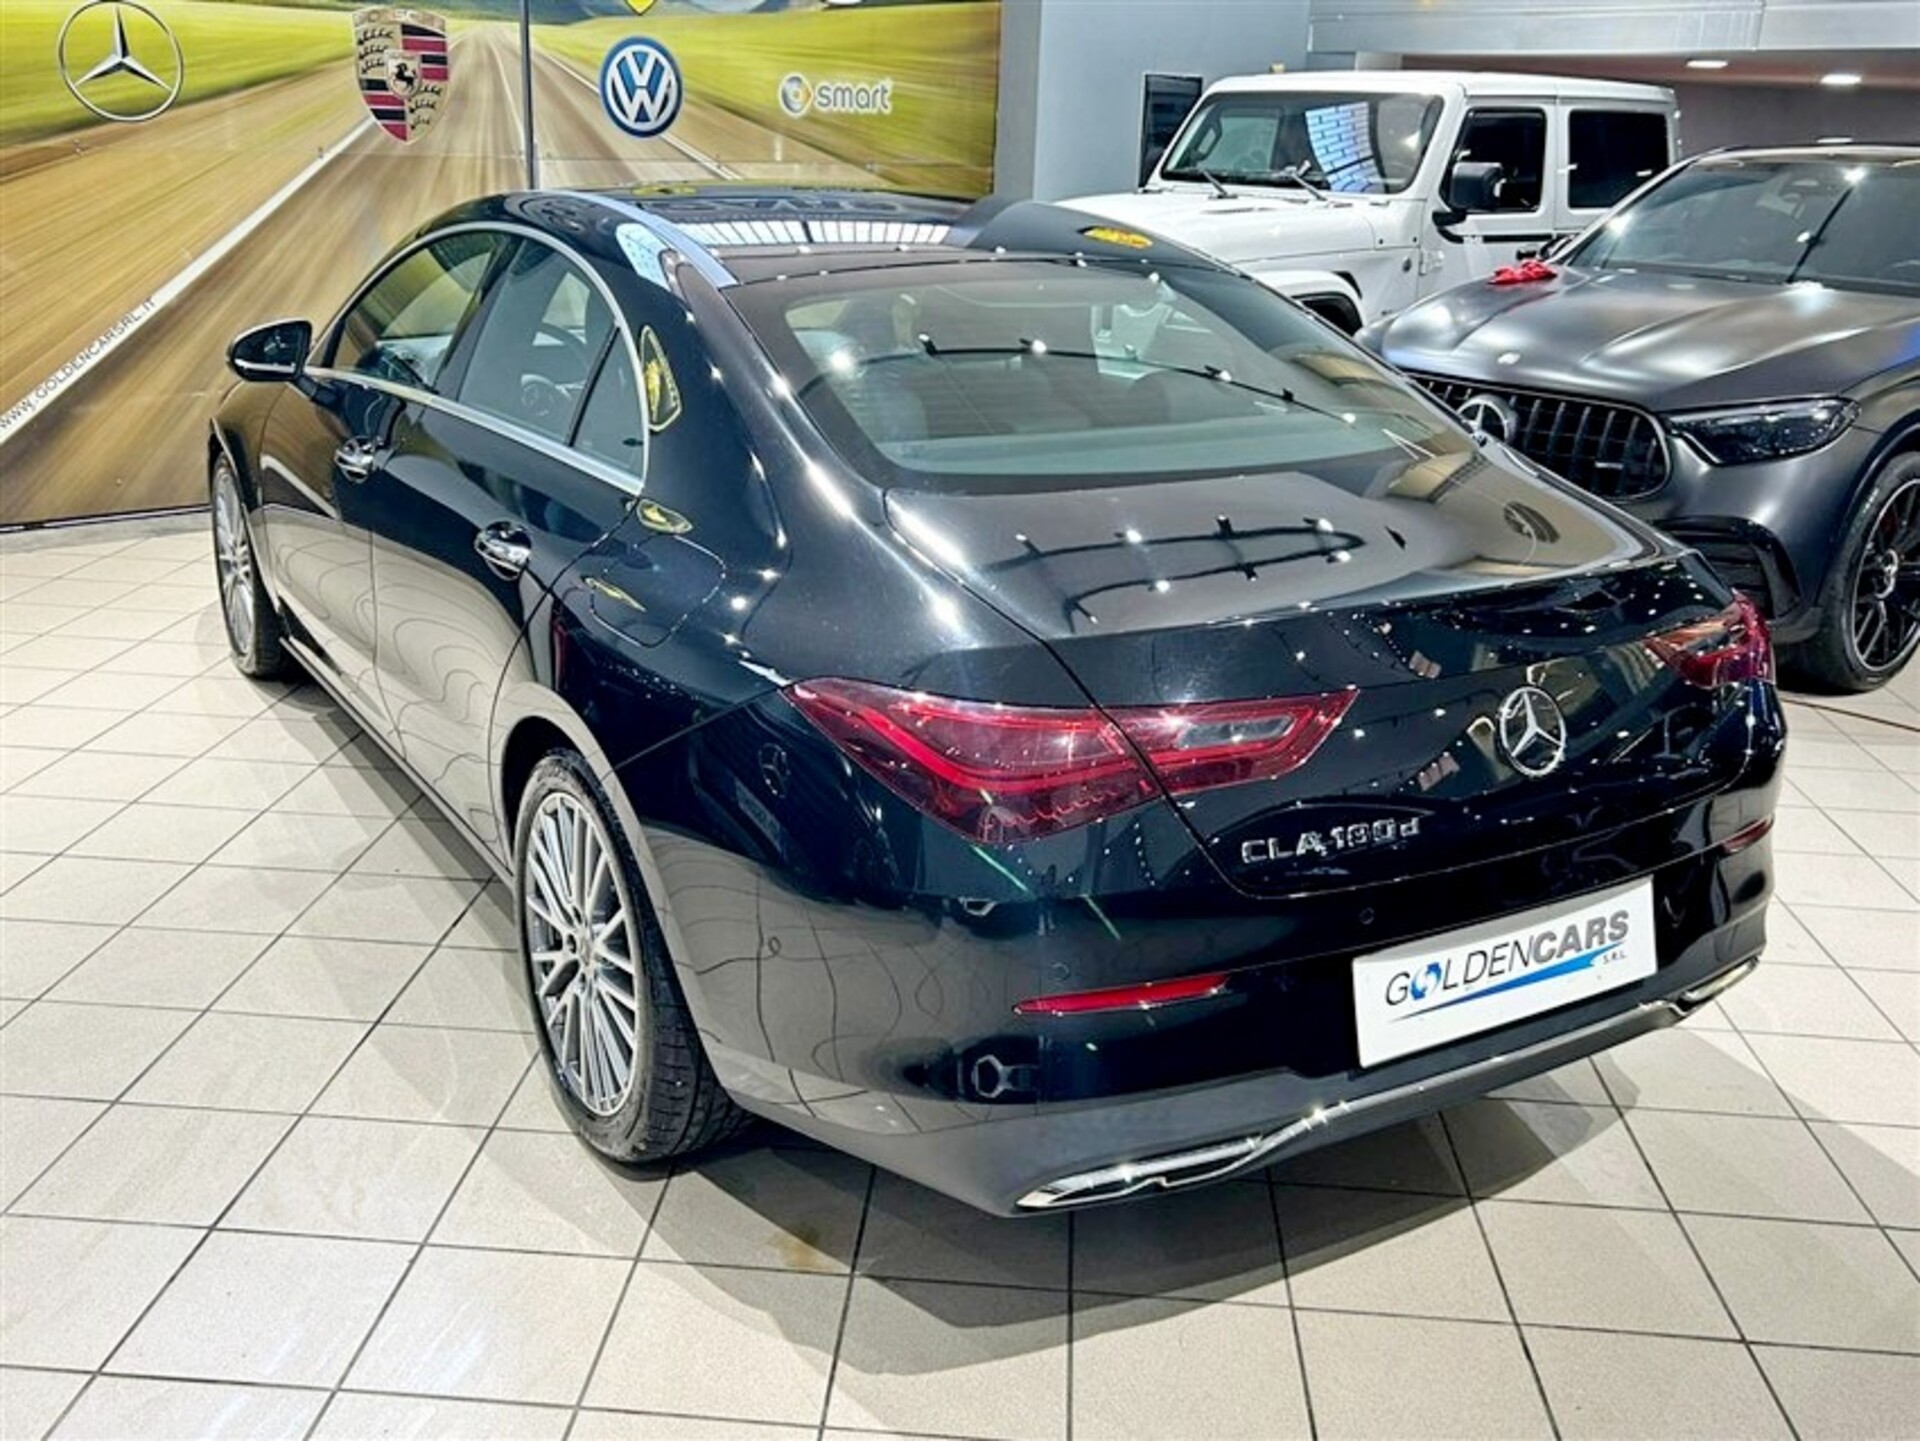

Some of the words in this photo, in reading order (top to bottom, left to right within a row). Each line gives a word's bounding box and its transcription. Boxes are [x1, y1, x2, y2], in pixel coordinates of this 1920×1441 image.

[816, 83, 890, 110] smart
[1241, 830, 1328, 864] CLA
[1385, 910, 1630, 1006] GOLDENCARS
